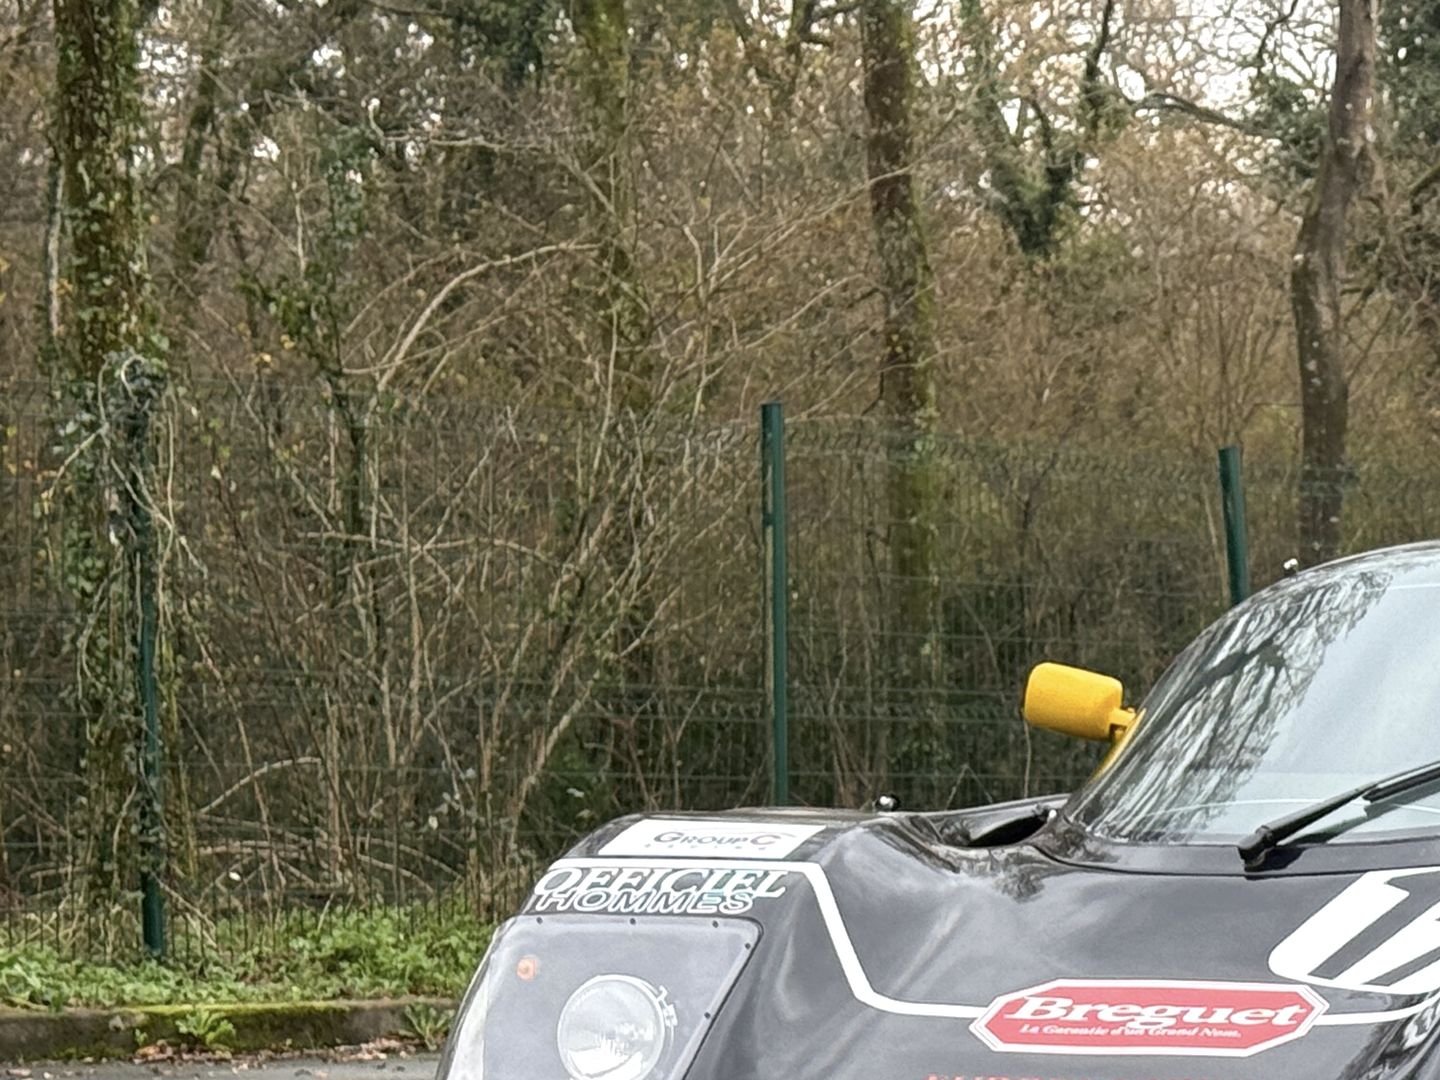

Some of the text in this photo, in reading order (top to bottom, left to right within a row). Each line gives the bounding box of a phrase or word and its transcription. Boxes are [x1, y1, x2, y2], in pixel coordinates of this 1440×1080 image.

[534, 867, 788, 898] OFFICIEL
[535, 887, 753, 914] HOMMES
[1003, 995, 1307, 1029] Breguet
